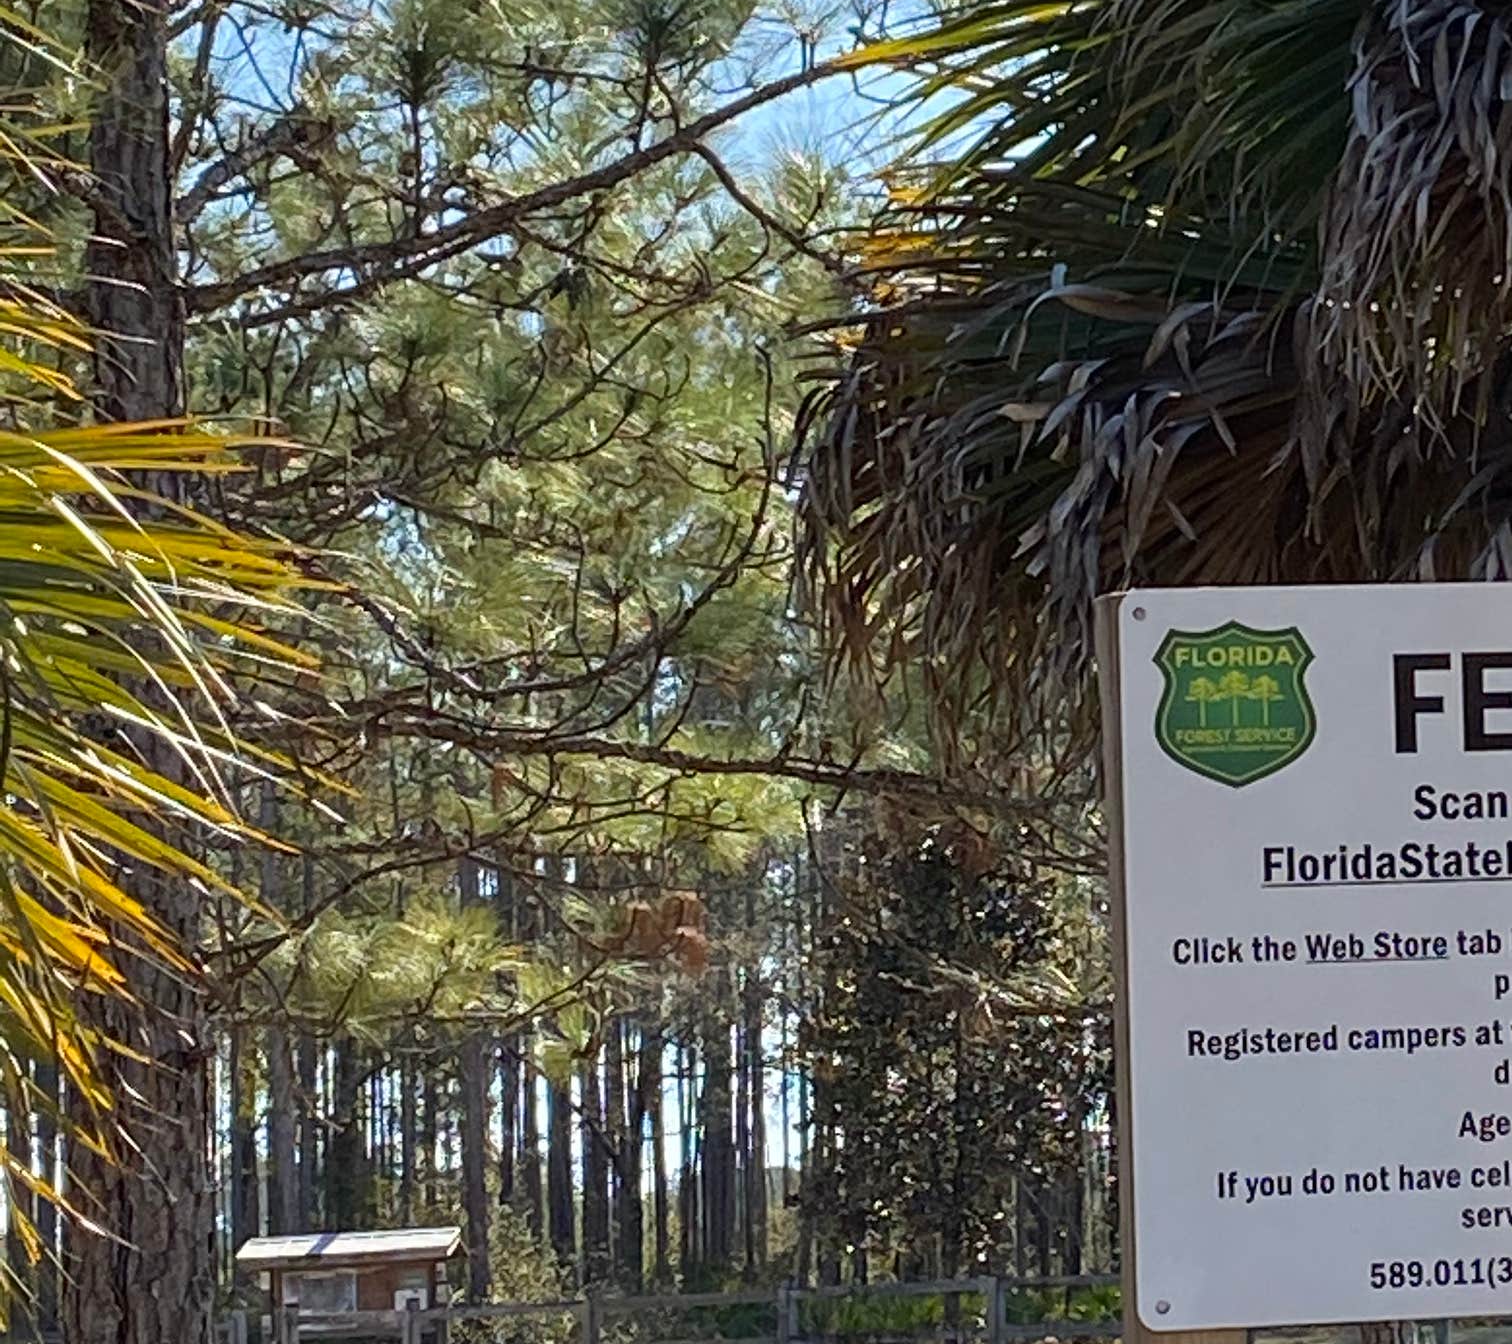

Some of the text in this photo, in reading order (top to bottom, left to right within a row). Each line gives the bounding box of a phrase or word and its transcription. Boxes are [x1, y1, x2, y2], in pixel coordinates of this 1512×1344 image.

[1174, 645, 1295, 668] FLORIDA
[1175, 730, 1231, 744] FOREST
[1413, 784, 1509, 821] Scan
[1172, 936, 1244, 965] Click
[1251, 934, 1297, 963] the
[1304, 933, 1366, 960] Web
[1373, 931, 1449, 958] Store
[1456, 928, 1502, 956] tab
[1187, 1024, 1339, 1061] Registered
[1347, 1026, 1467, 1055] campers
[1474, 1019, 1504, 1046] at
[1458, 1111, 1512, 1143] Age
[1218, 1170, 1239, 1199] If
[1244, 1175, 1293, 1205] you
[1302, 1167, 1335, 1196] do
[1344, 1165, 1391, 1193] not
[1398, 1163, 1461, 1192] have
